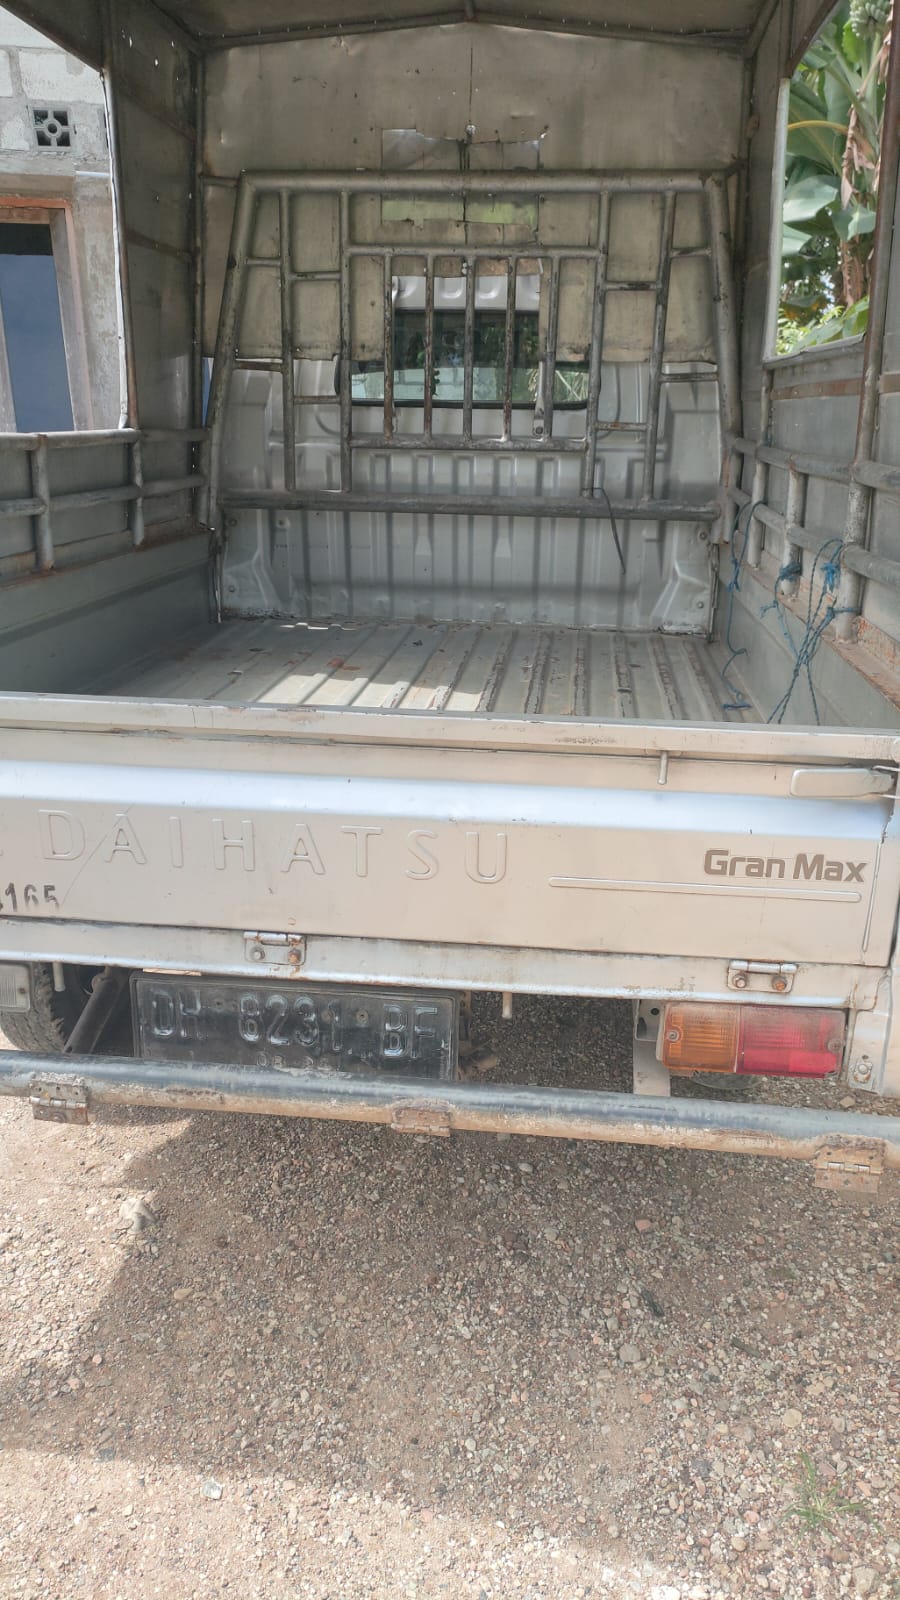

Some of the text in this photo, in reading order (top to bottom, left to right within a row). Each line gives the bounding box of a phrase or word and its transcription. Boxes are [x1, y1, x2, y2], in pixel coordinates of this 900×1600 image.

[38, 809, 508, 884] DAIHATSU
[704, 849, 867, 882] Gran Max
[0, 882, 59, 912] 165
